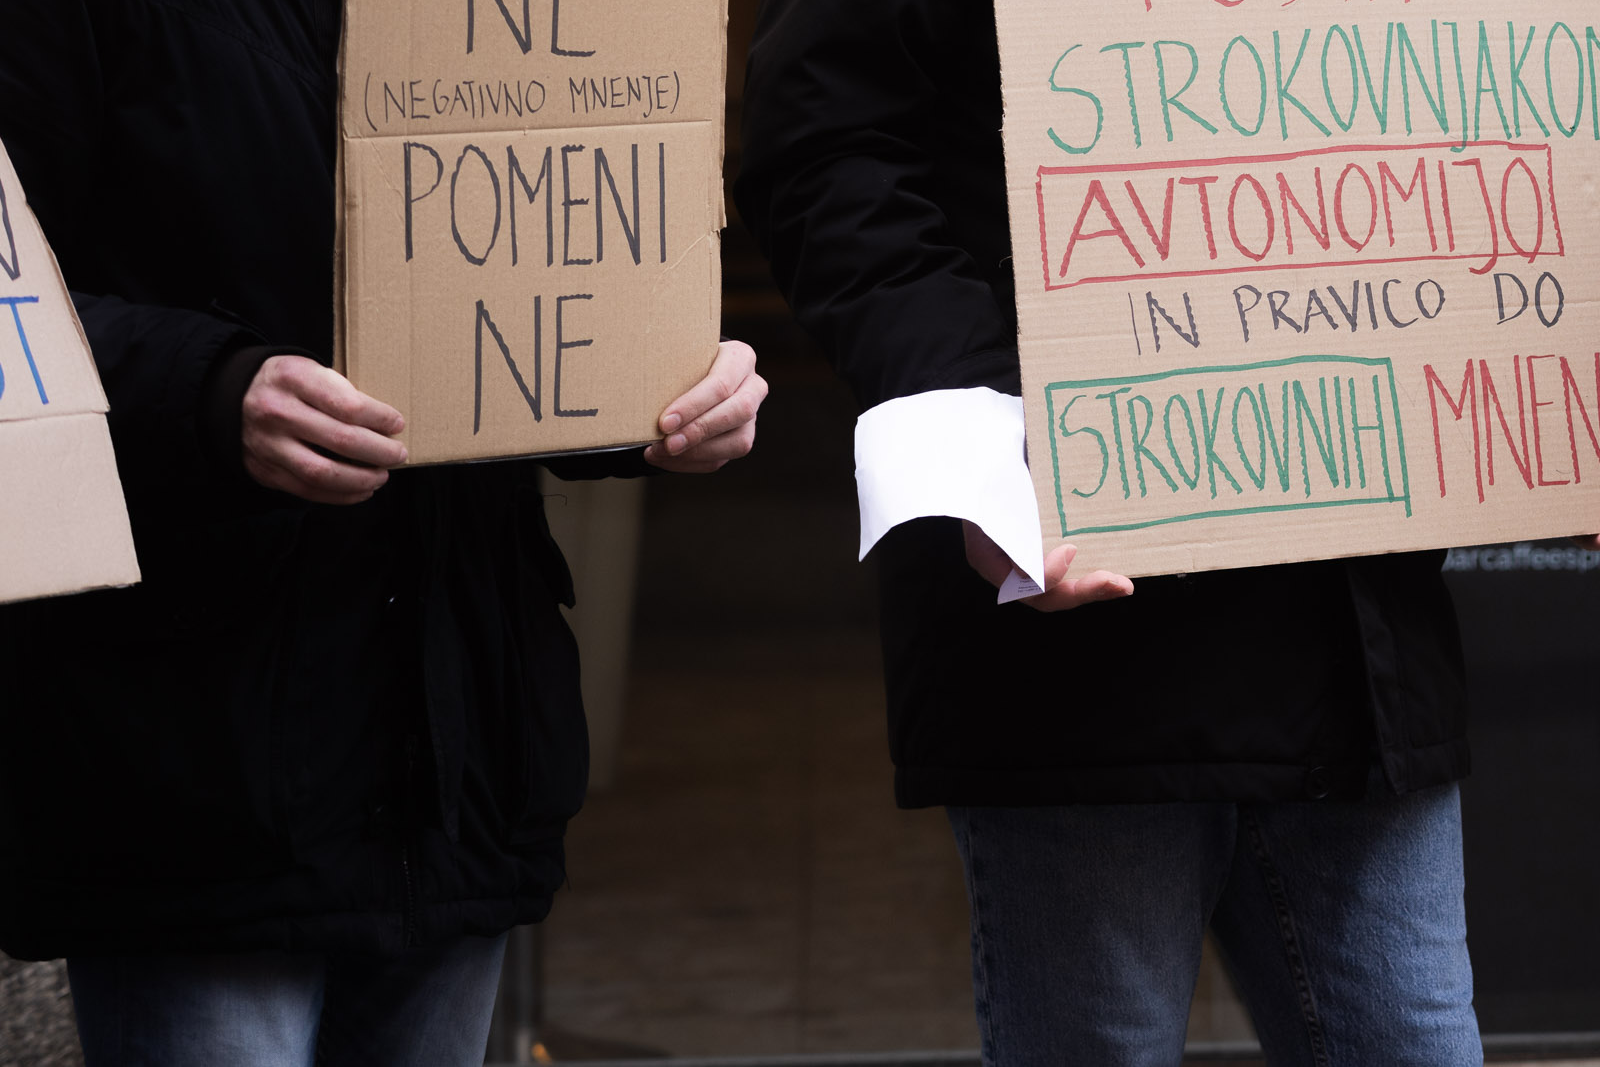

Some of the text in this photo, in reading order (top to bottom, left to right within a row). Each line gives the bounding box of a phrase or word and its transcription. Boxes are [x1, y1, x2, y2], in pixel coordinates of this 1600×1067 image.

[364, 71, 681, 132] (NEGATIVNO MNENJE)
[403, 141, 668, 267] POMENI
[1060, 157, 1544, 278] AVTONOMIJO
[474, 294, 600, 435] NE
[1130, 271, 1566, 356] IN PRAVICO DO
[1060, 375, 1394, 501] STROKOVNIH
